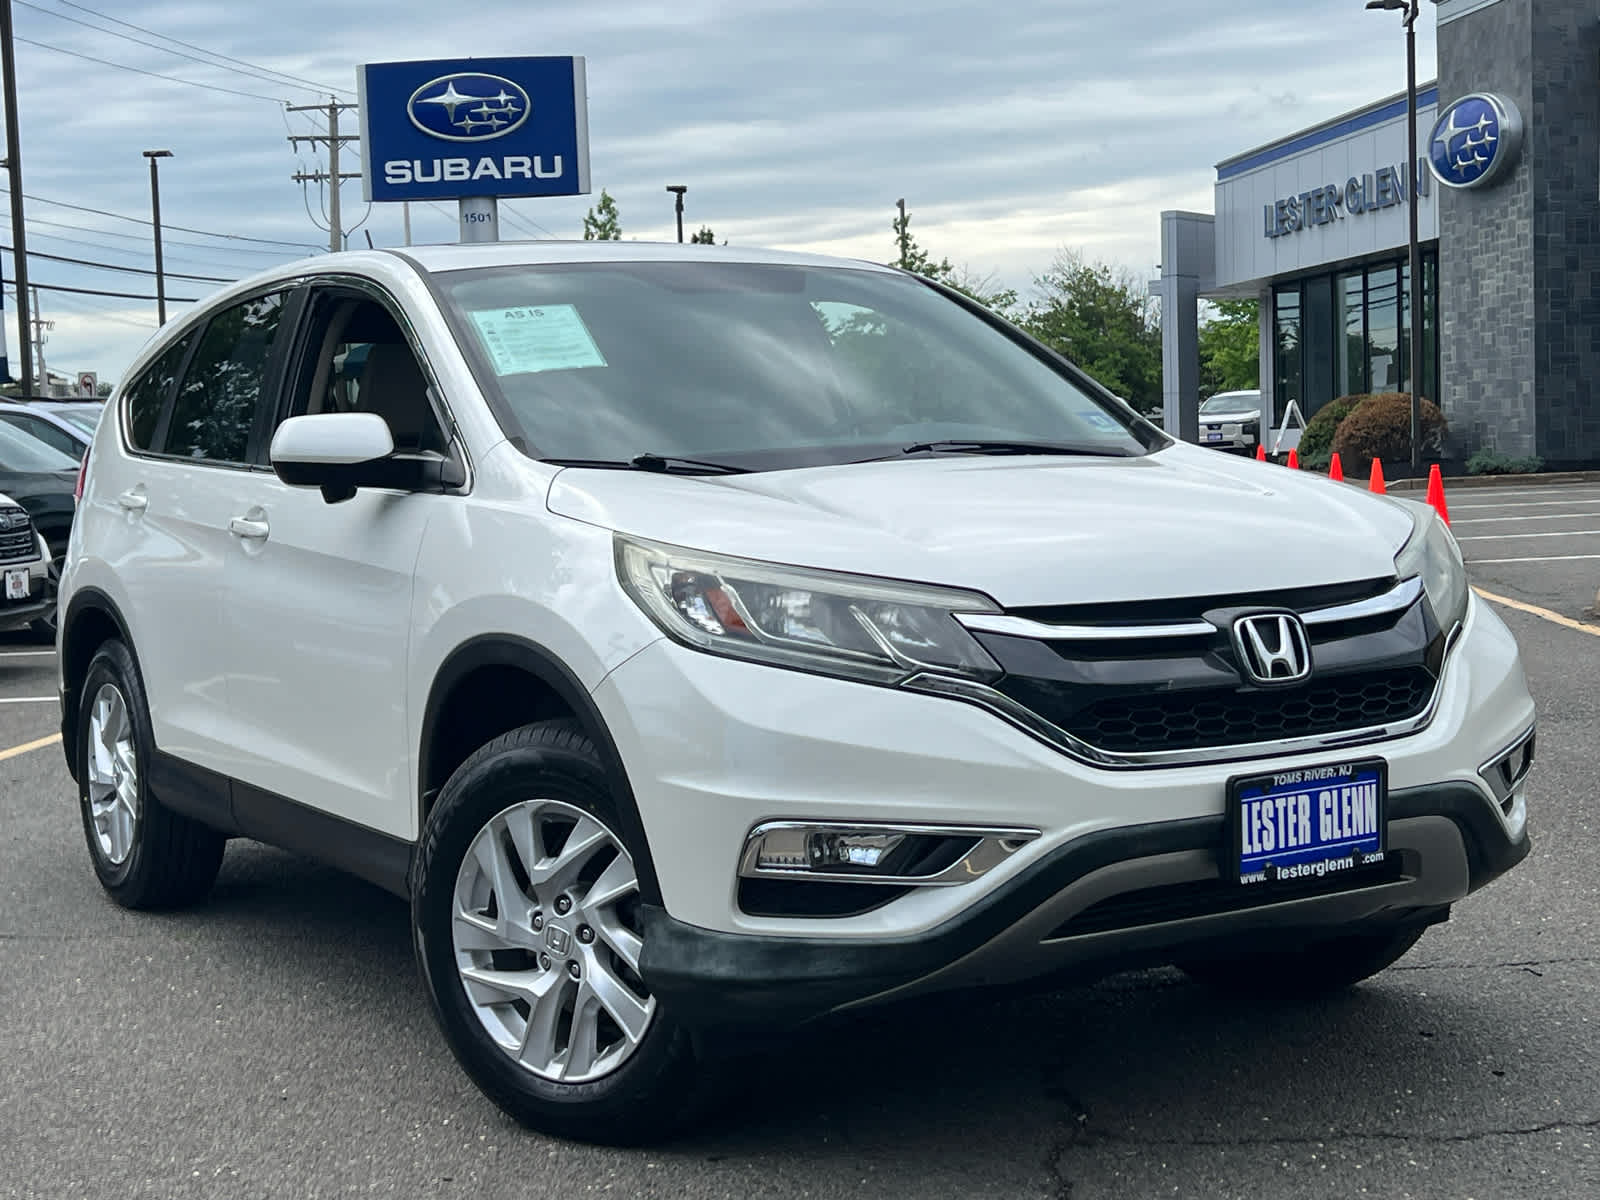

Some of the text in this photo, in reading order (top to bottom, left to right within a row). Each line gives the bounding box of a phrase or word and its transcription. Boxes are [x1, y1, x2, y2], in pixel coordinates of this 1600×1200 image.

[384, 155, 563, 184] SUBARU
[464, 212, 492, 224] 1501
[1264, 184, 1344, 239] LESTER
[505, 309, 545, 319] AS IS
[1273, 773, 1302, 787] TOMS
[1338, 765, 1353, 777] NJ
[1241, 784, 1377, 855] LESTER GLENN
[1240, 852, 1384, 885] www. lesterglenn .com
